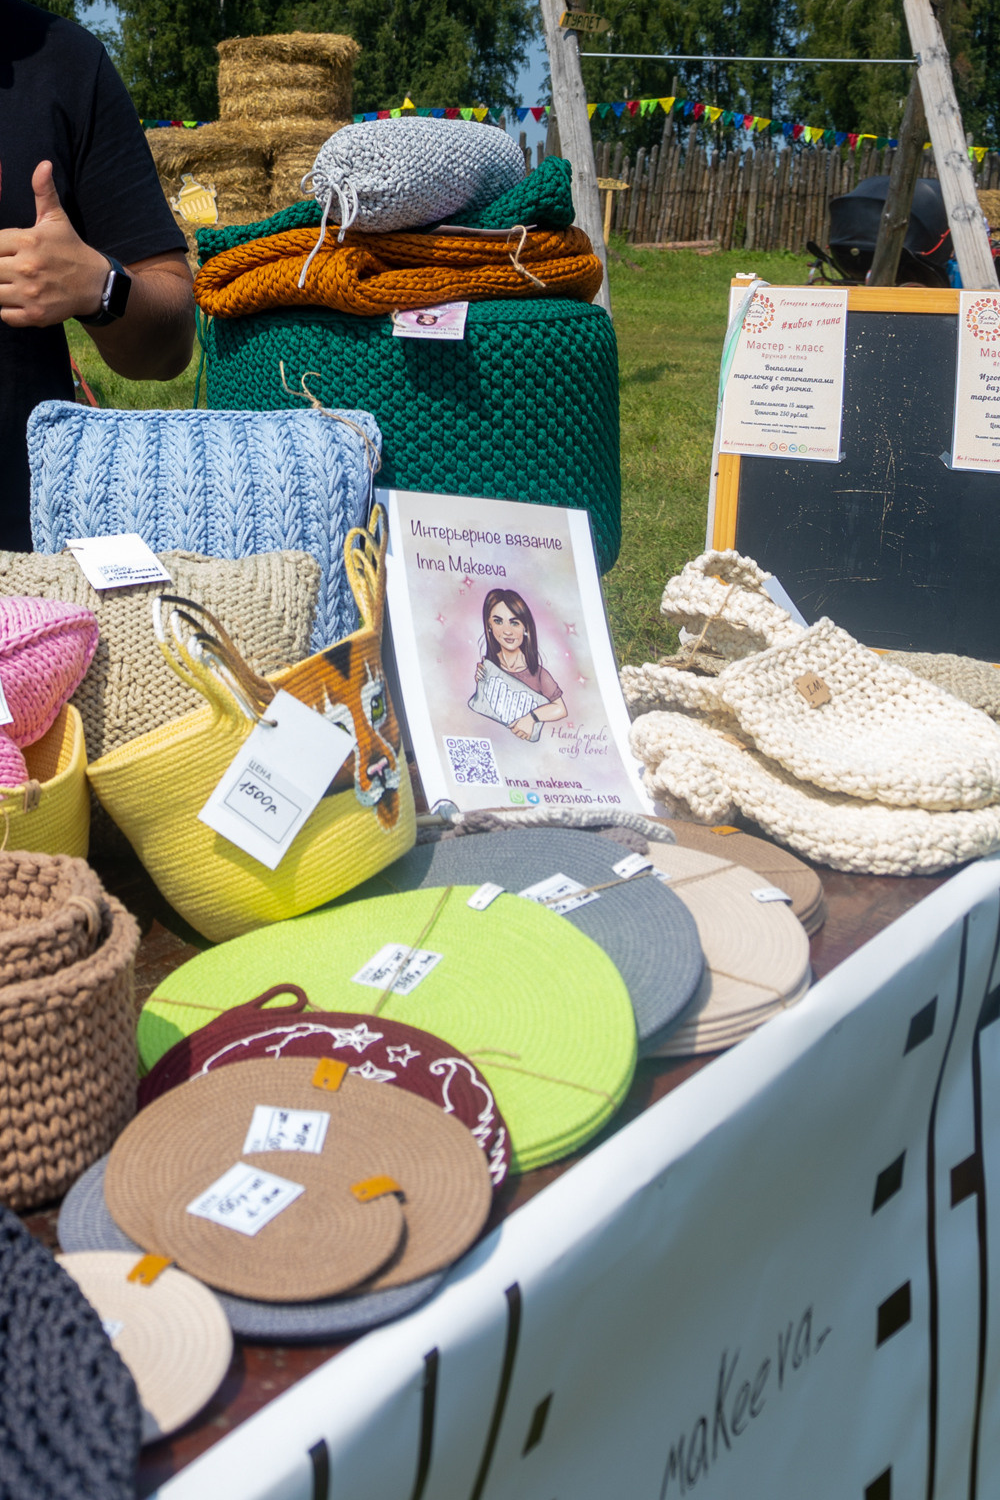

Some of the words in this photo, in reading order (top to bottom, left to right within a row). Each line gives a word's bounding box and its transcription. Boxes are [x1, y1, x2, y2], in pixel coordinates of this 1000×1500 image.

[746, 340, 784, 351] Мастер
[795, 343, 824, 353] класс
[733, 373, 773, 382] тарелочку
[780, 376, 834, 384] отпечатками
[411, 519, 502, 548] Интерьерное
[505, 533, 563, 551] вязание
[416, 553, 445, 572] Inna
[448, 555, 507, 577] Makeeva
[551, 724, 584, 741] Hand
[583, 725, 608, 741] made
[558, 744, 581, 759] with
[584, 740, 608, 756] love!
[248, 759, 271, 781] ЦЕНА
[505, 776, 591, 791] inna_makeeva_
[543, 794, 621, 805] 8(923)600-6180
